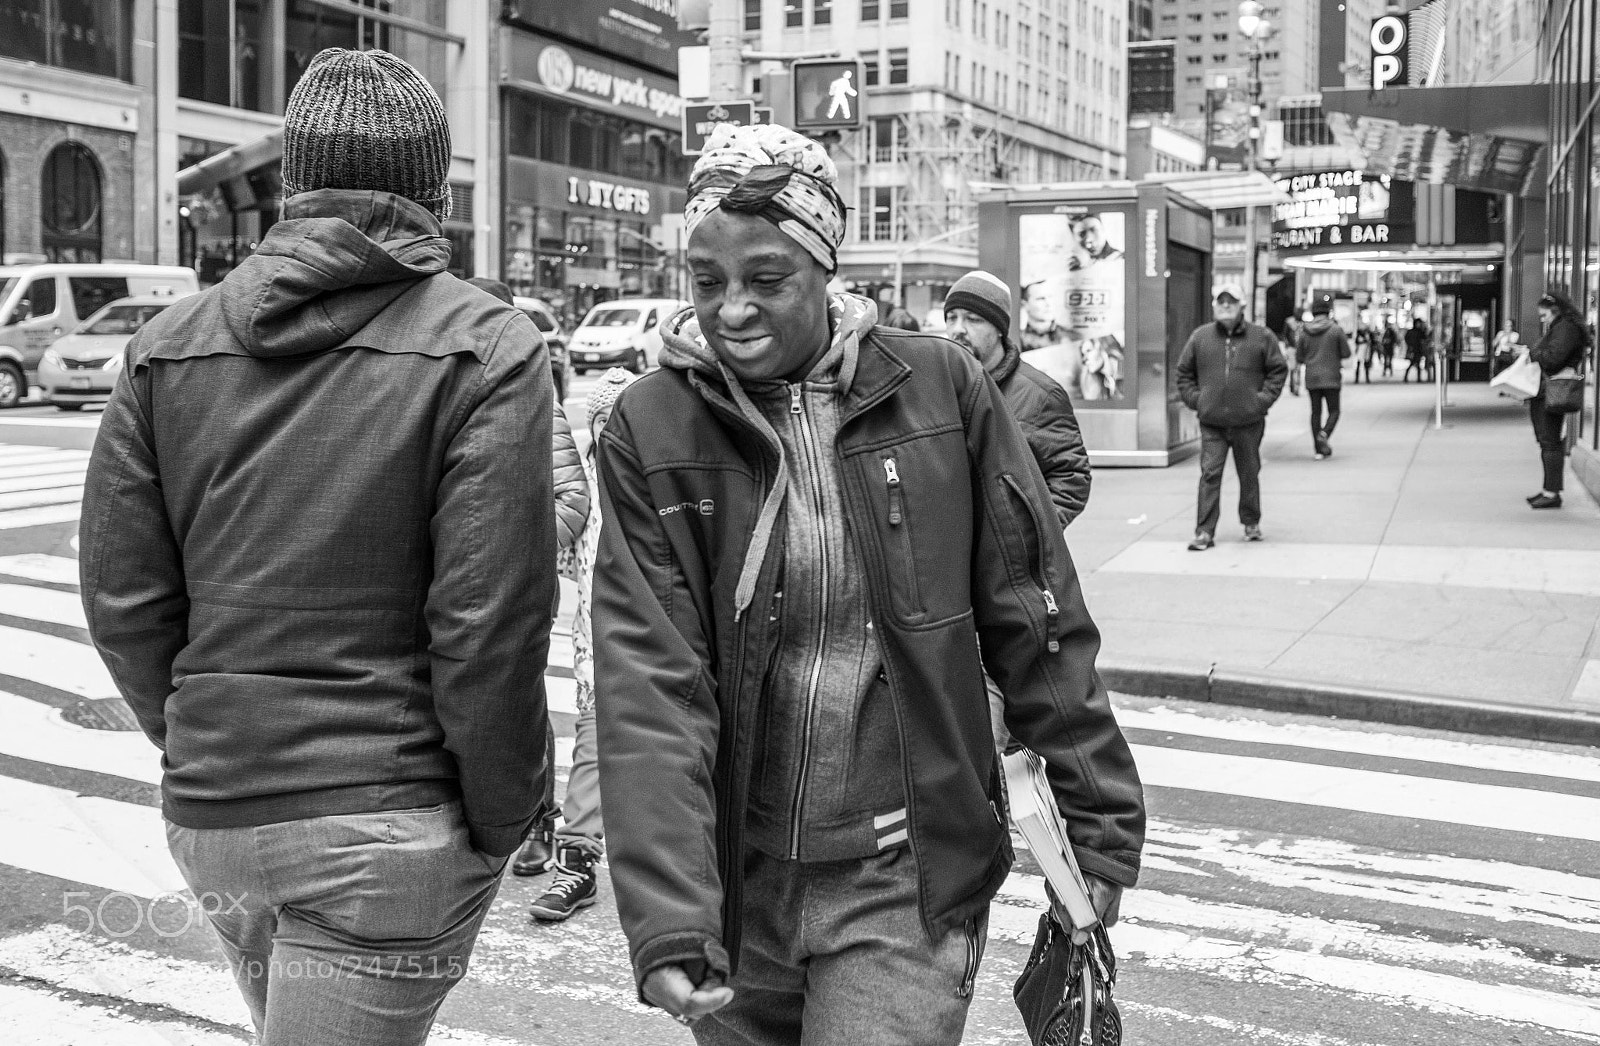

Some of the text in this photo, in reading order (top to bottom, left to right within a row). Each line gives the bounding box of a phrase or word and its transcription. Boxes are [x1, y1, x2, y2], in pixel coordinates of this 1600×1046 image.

[574, 65, 612, 96] new
[612, 77, 648, 108] york
[1319, 169, 1363, 188] STAGE
[568, 176, 579, 203] I
[588, 180, 615, 209] NY
[1329, 226, 1342, 244] &
[1350, 224, 1389, 243] BAR
